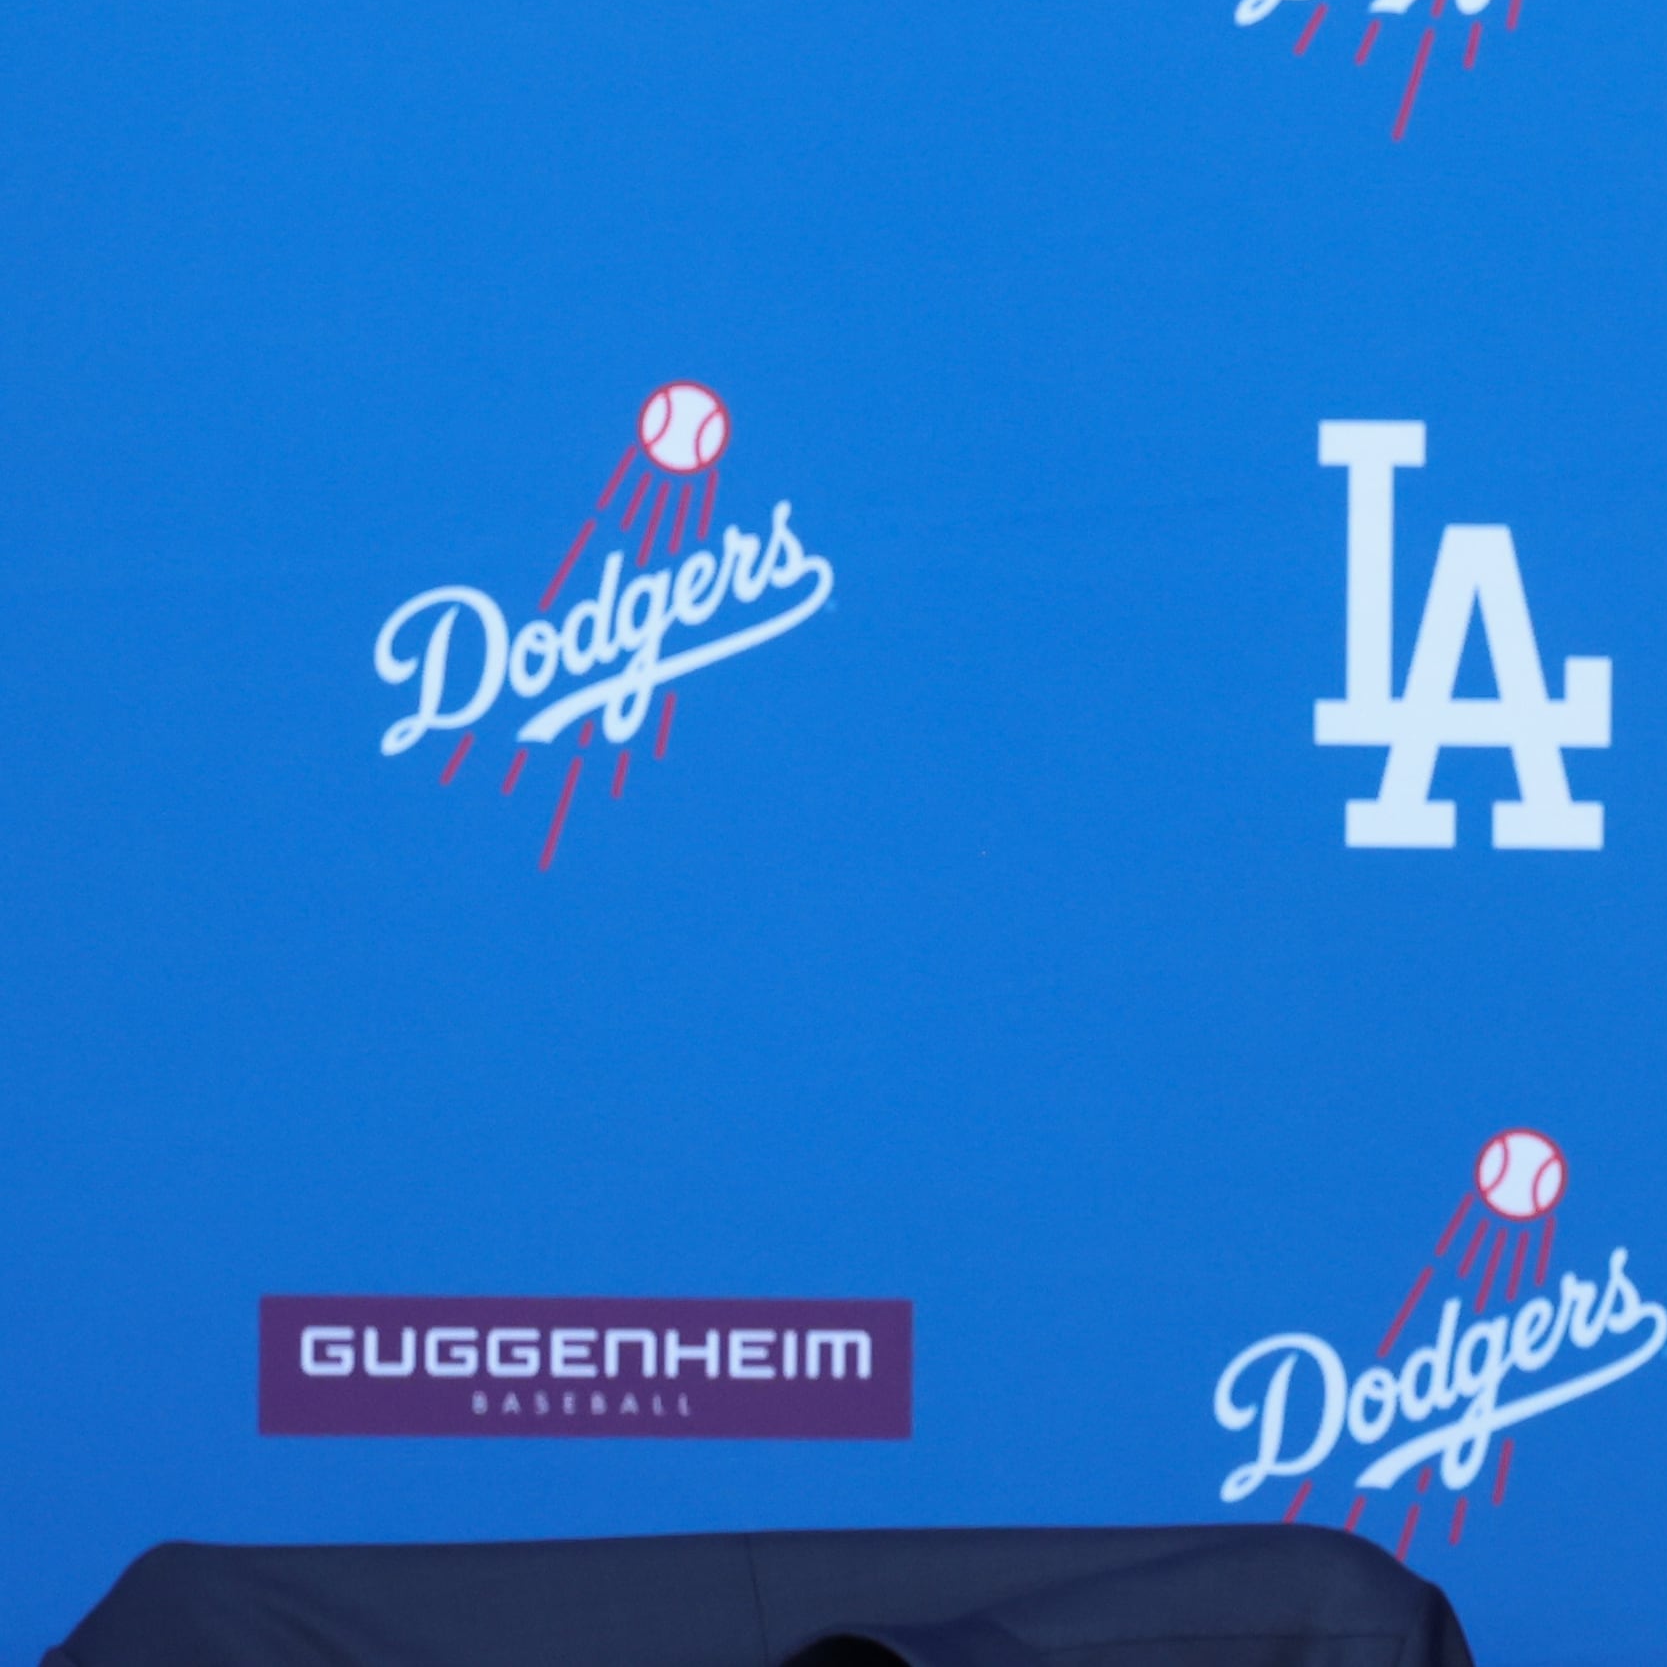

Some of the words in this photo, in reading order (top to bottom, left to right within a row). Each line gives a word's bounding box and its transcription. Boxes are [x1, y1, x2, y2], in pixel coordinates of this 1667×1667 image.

[375, 501, 833, 755] Dodgers
[1314, 420, 1612, 850] LA
[300, 1325, 873, 1380] GUGGENHEIM
[472, 1393, 690, 1418] BASEBALL
